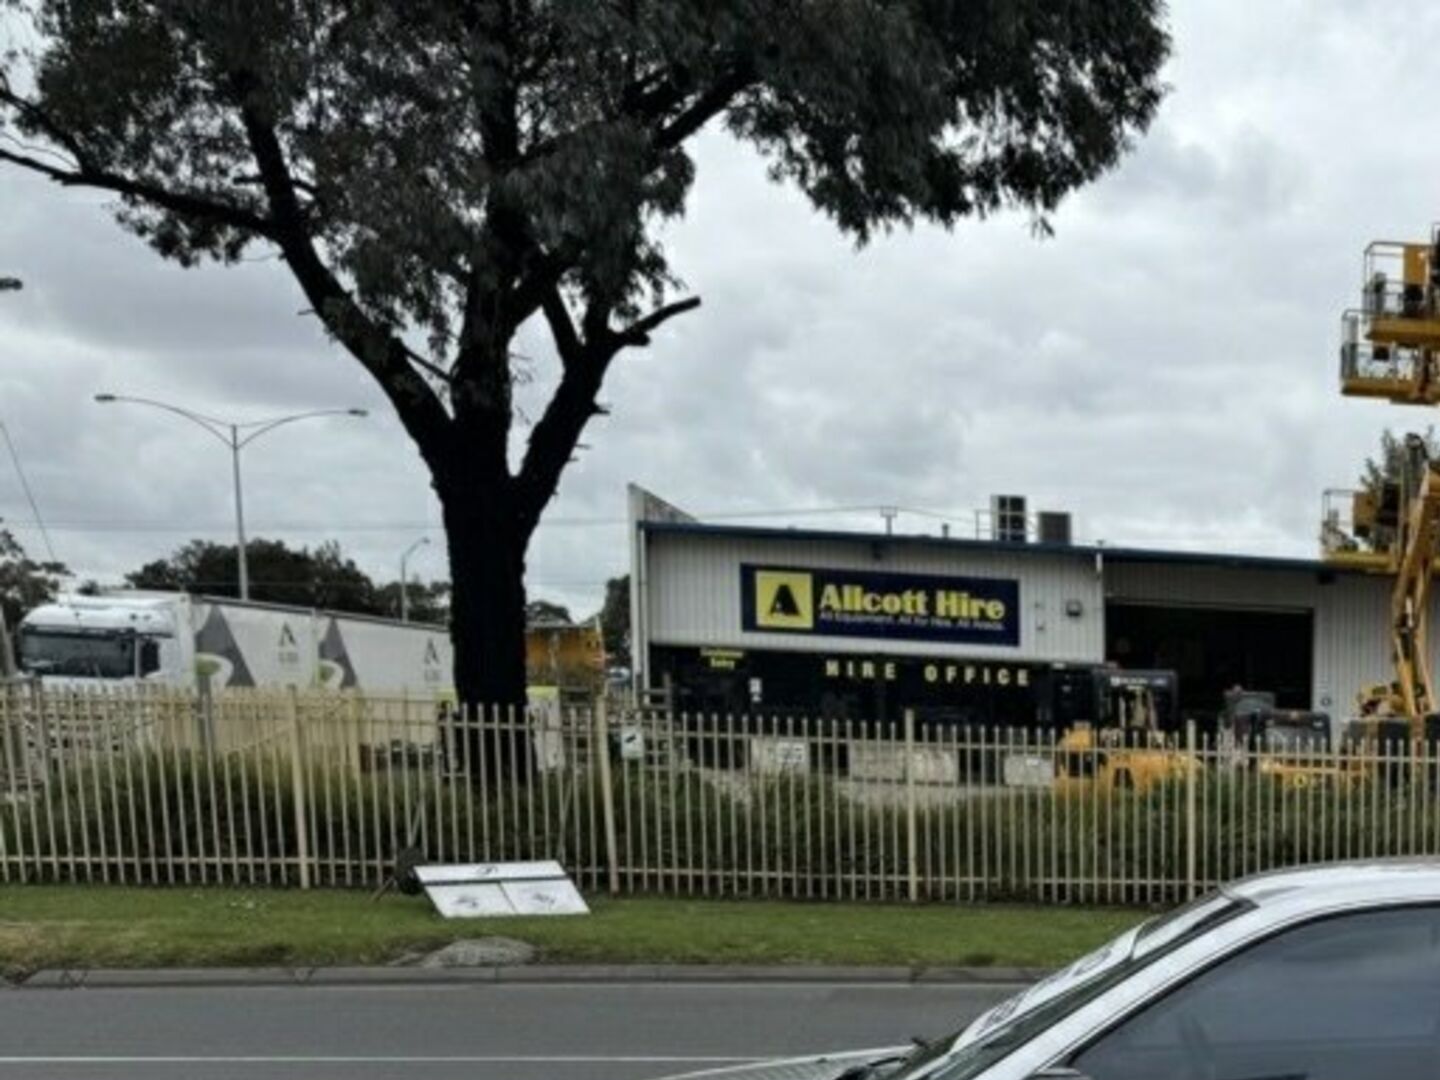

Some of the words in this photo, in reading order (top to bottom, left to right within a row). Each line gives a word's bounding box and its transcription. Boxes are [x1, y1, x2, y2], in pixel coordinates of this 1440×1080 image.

[819, 584, 929, 615] Allcott
[935, 590, 1006, 620] Hire
[825, 659, 896, 680] HIRE
[924, 663, 1029, 687] OFFICE
